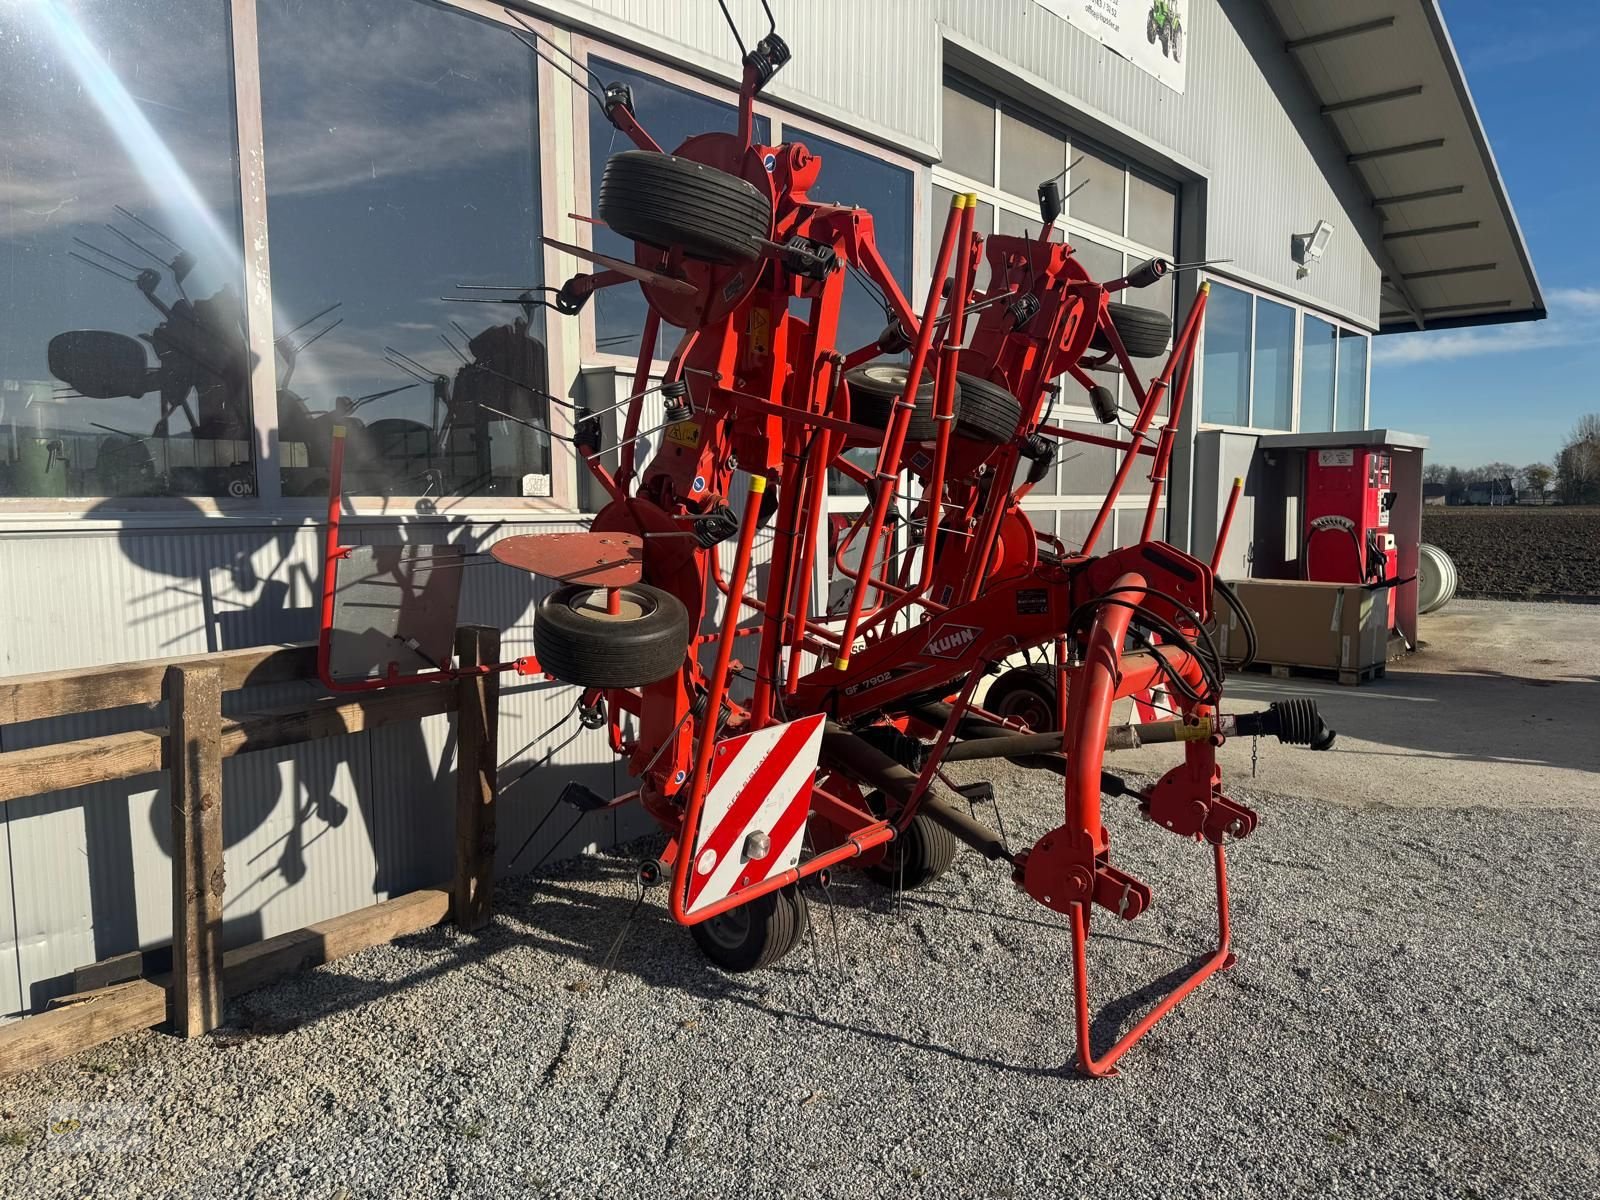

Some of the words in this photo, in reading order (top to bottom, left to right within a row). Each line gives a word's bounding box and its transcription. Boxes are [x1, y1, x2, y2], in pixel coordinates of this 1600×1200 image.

[928, 628, 974, 655] KUHN
[845, 683, 860, 696] GF
[862, 671, 892, 688] 7902
